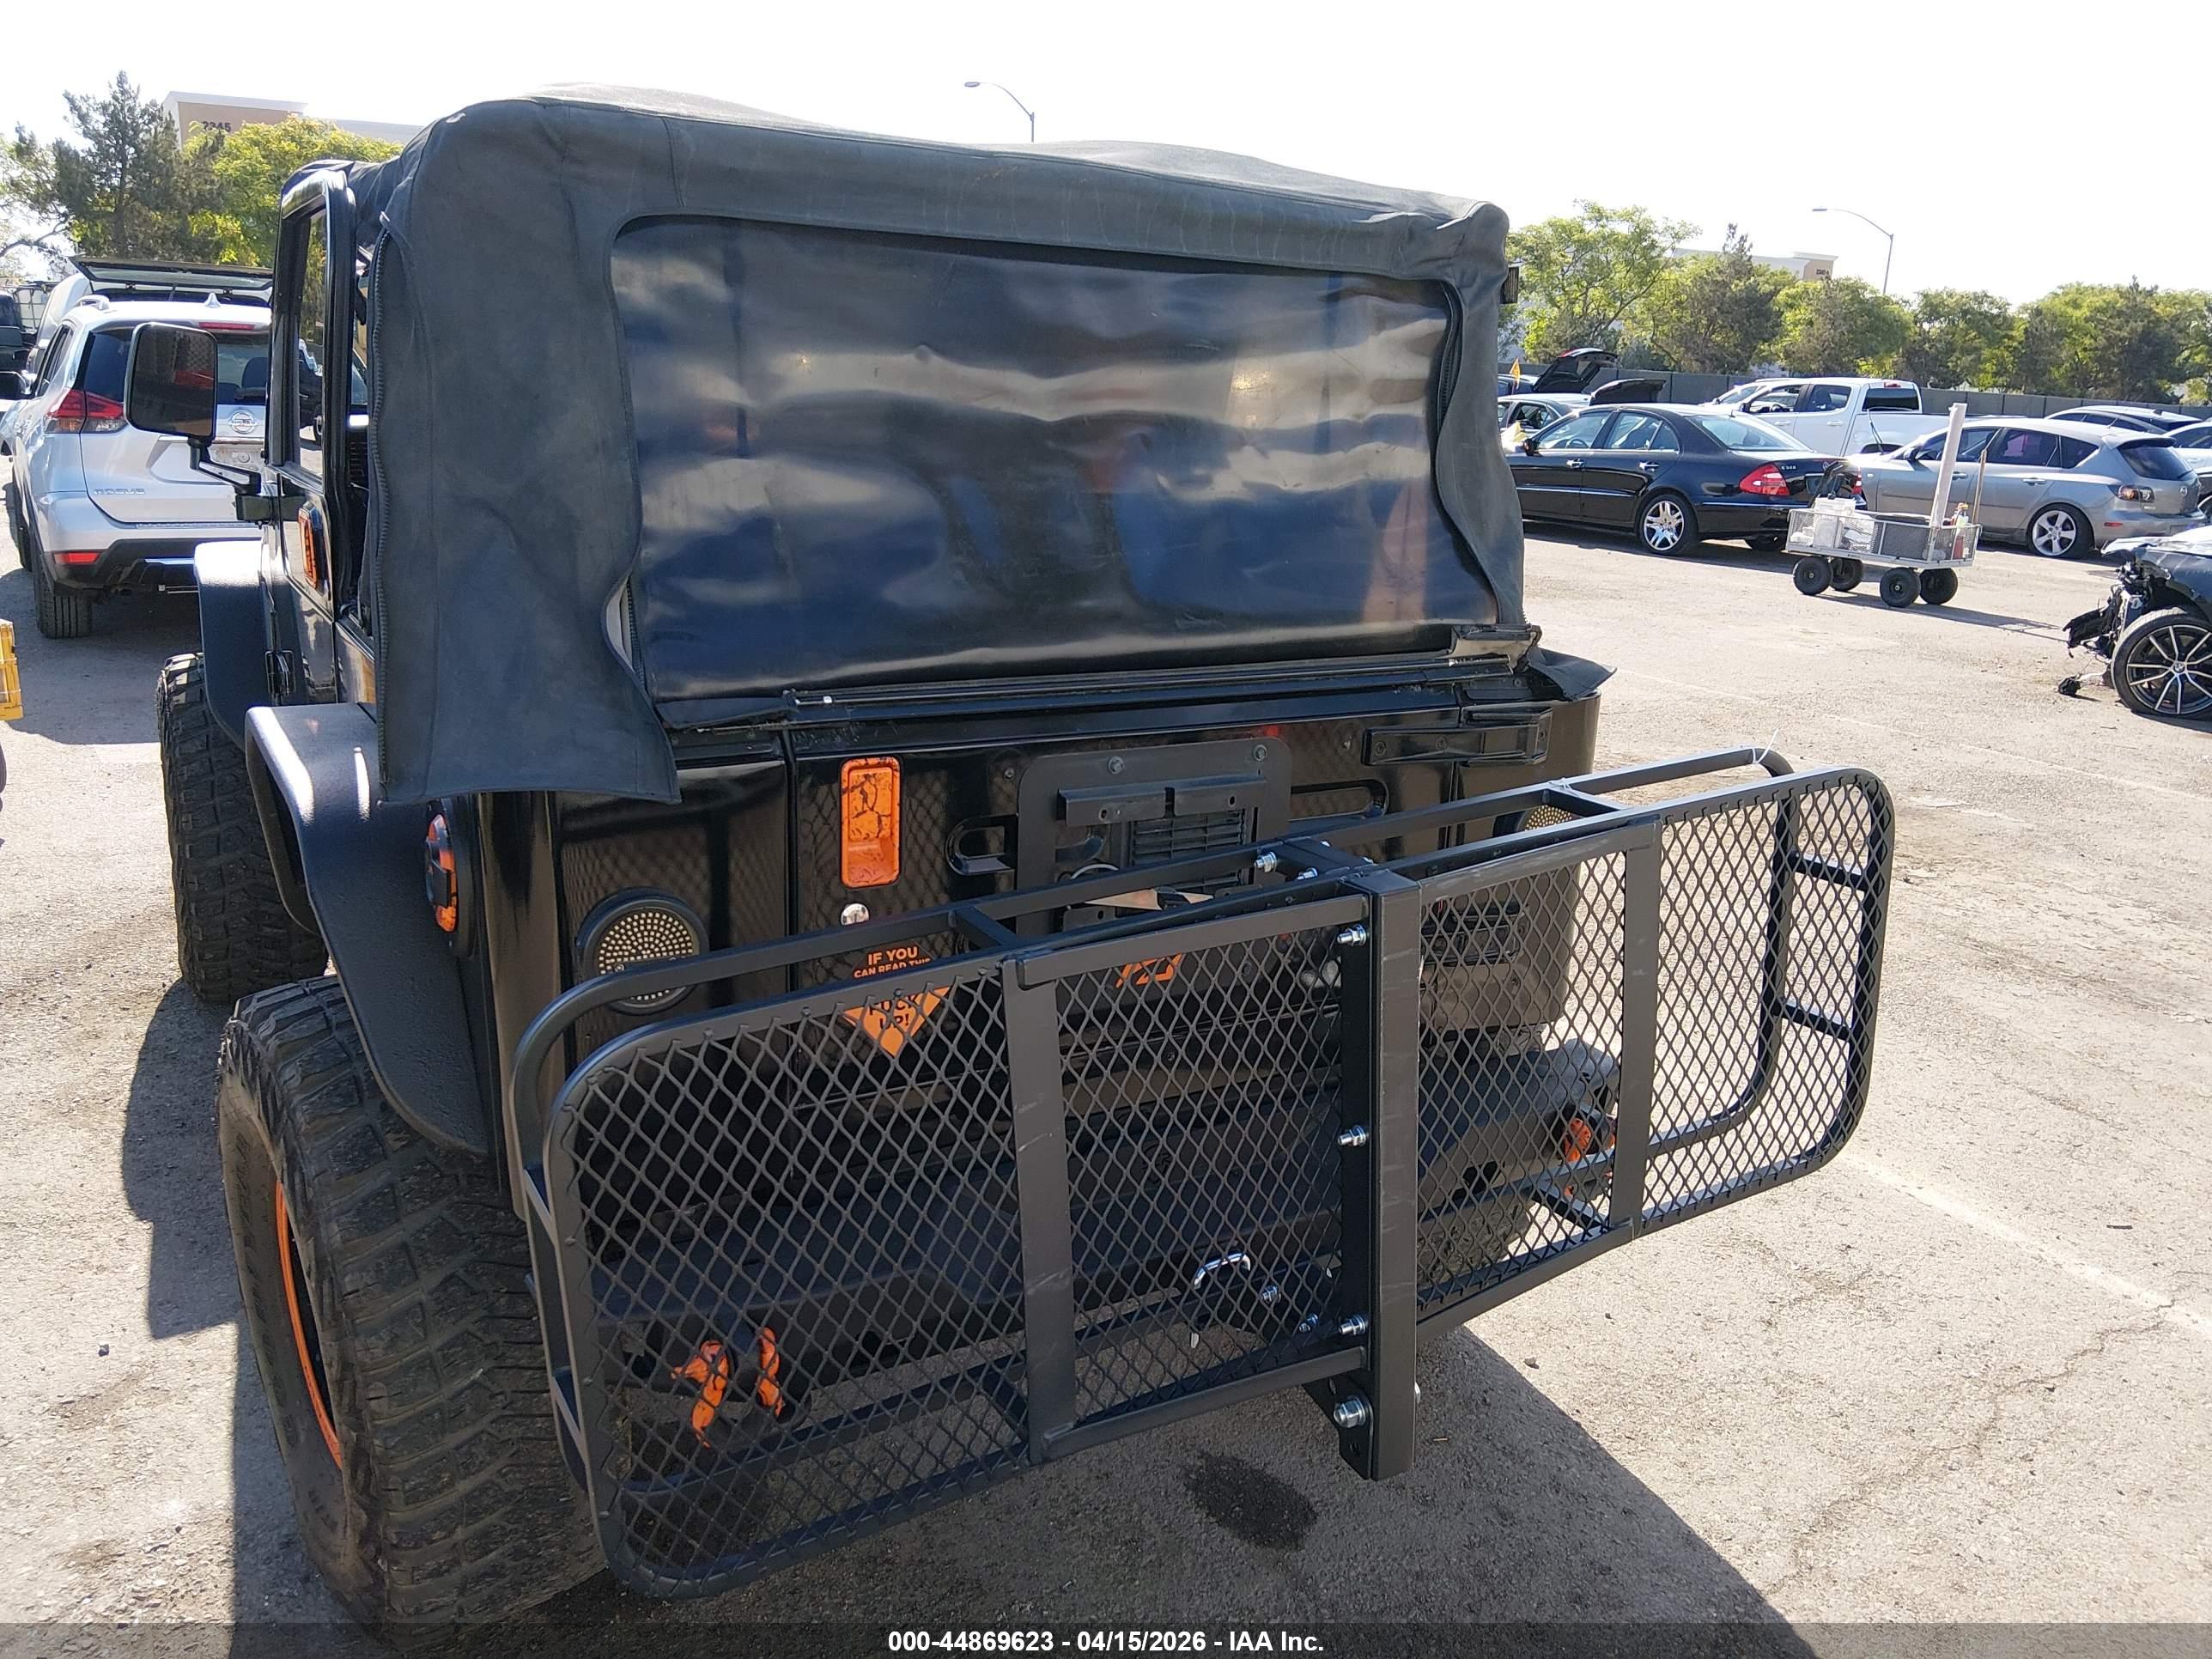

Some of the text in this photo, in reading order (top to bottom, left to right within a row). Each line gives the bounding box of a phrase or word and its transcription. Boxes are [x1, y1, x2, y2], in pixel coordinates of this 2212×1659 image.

[868, 946, 918, 965] IF YOU
[854, 967, 876, 978] CAN
[878, 962, 907, 972] READ
